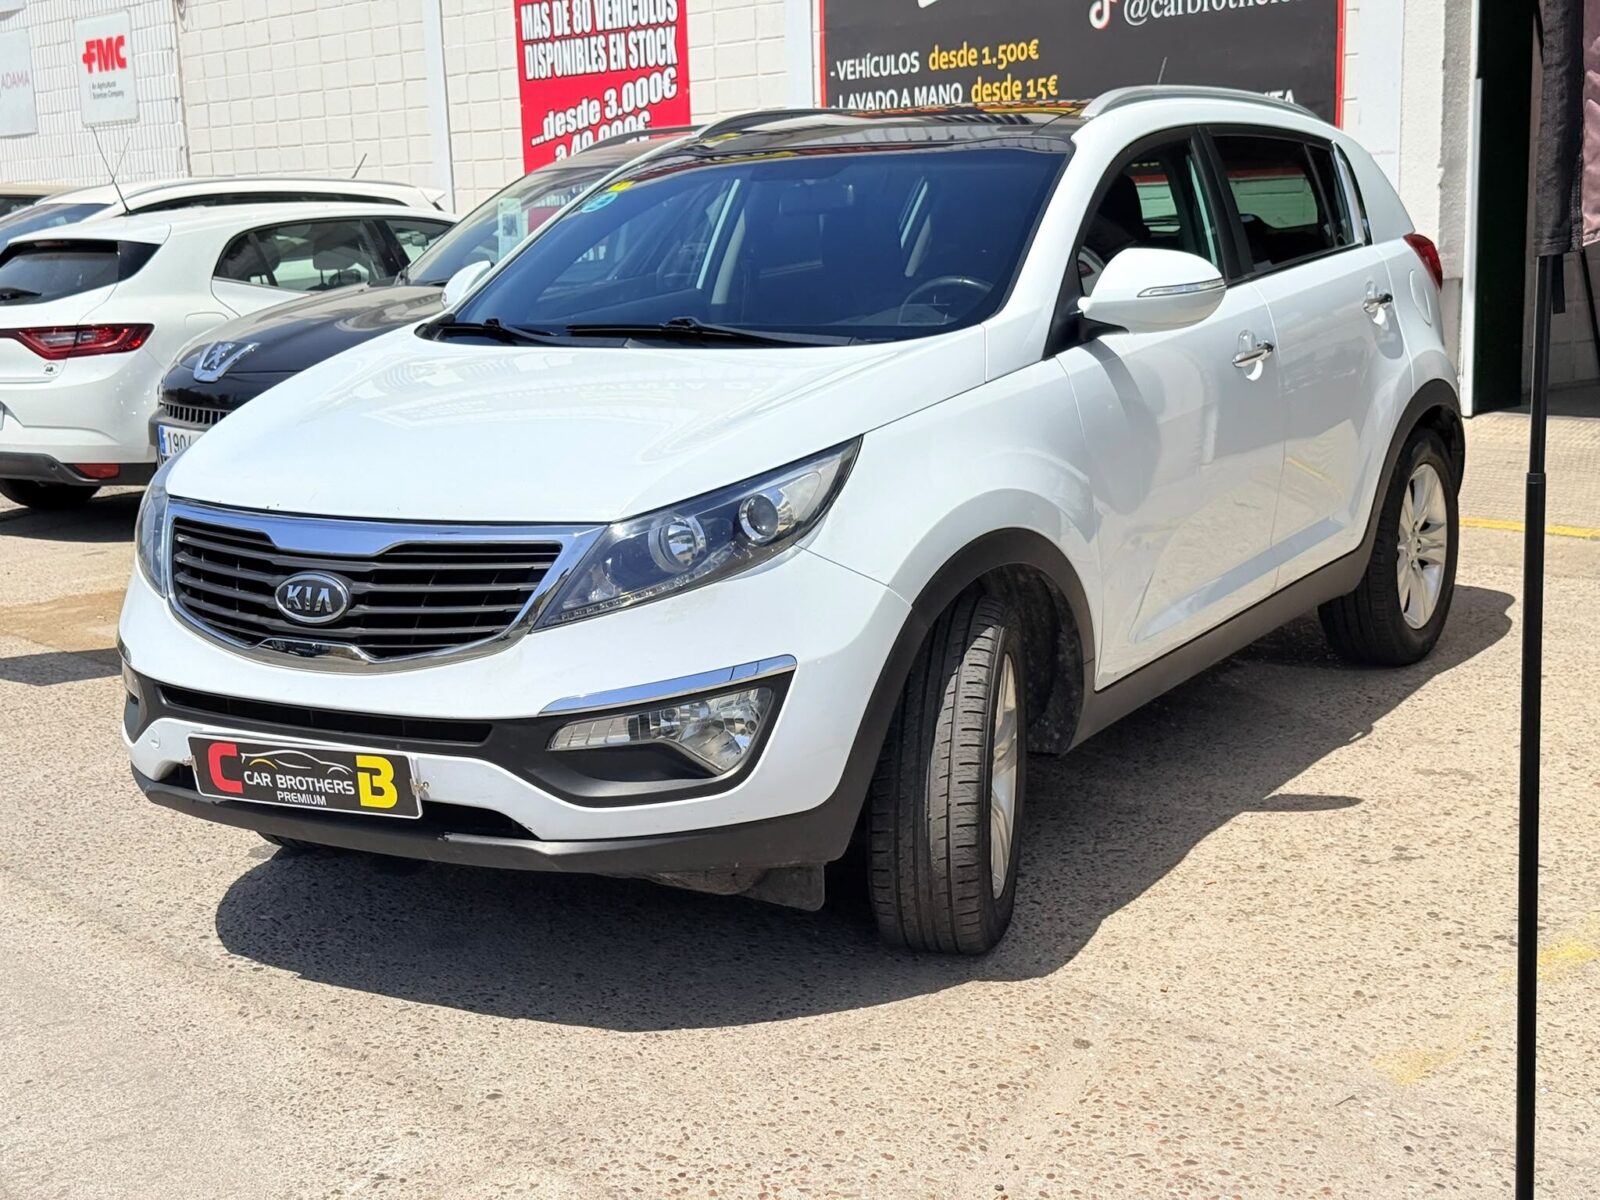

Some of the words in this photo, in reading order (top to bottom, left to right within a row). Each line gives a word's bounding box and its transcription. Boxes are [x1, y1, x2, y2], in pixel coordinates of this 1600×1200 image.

[521, 2, 550, 40] MAS
[552, 1, 571, 37] DE
[572, 0, 592, 35] 80
[82, 35, 128, 74] FMC
[524, 35, 607, 80] DISPONIBLES
[608, 33, 627, 71] EN
[628, 26, 678, 70] STOCK
[928, 41, 978, 71] desde
[981, 39, 1039, 70] 1.500€
[1, 71, 30, 89] ADAMA
[604, 67, 677, 119] 3.000€
[901, 88, 911, 107] A
[914, 82, 963, 106] MANO
[970, 74, 1022, 103] desde
[1026, 75, 1058, 100] 15€
[286, 584, 333, 612] KIA
[207, 741, 243, 793] C
[244, 771, 273, 788] CAR
[276, 774, 355, 795] BROTHERS
[277, 790, 327, 806] PREMIUM
